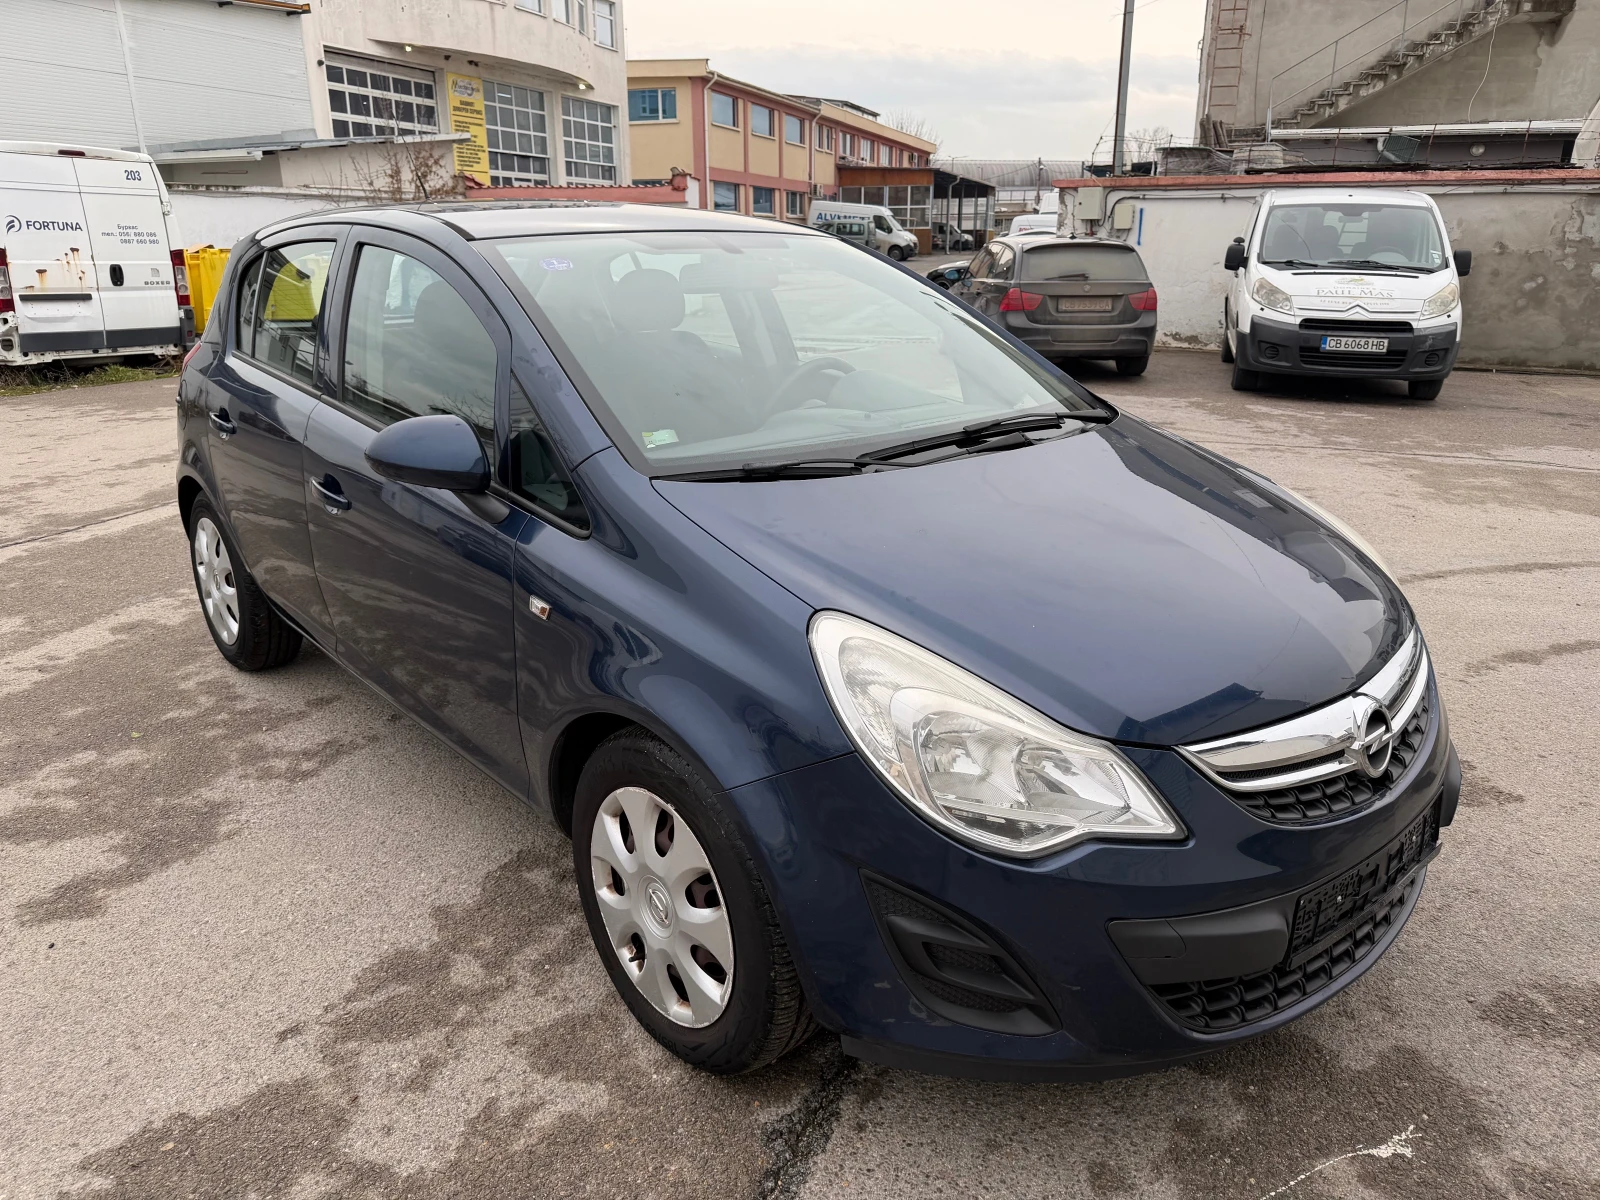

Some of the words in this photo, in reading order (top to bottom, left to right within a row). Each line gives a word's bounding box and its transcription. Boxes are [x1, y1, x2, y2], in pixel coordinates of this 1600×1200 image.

[124, 169, 142, 182] 203
[25, 220, 83, 232] FORTUNA
[1359, 289, 1393, 298] MAS
[1328, 338, 1342, 349] CB
[1343, 339, 1370, 350] 6068
[1370, 340, 1385, 351] HB
